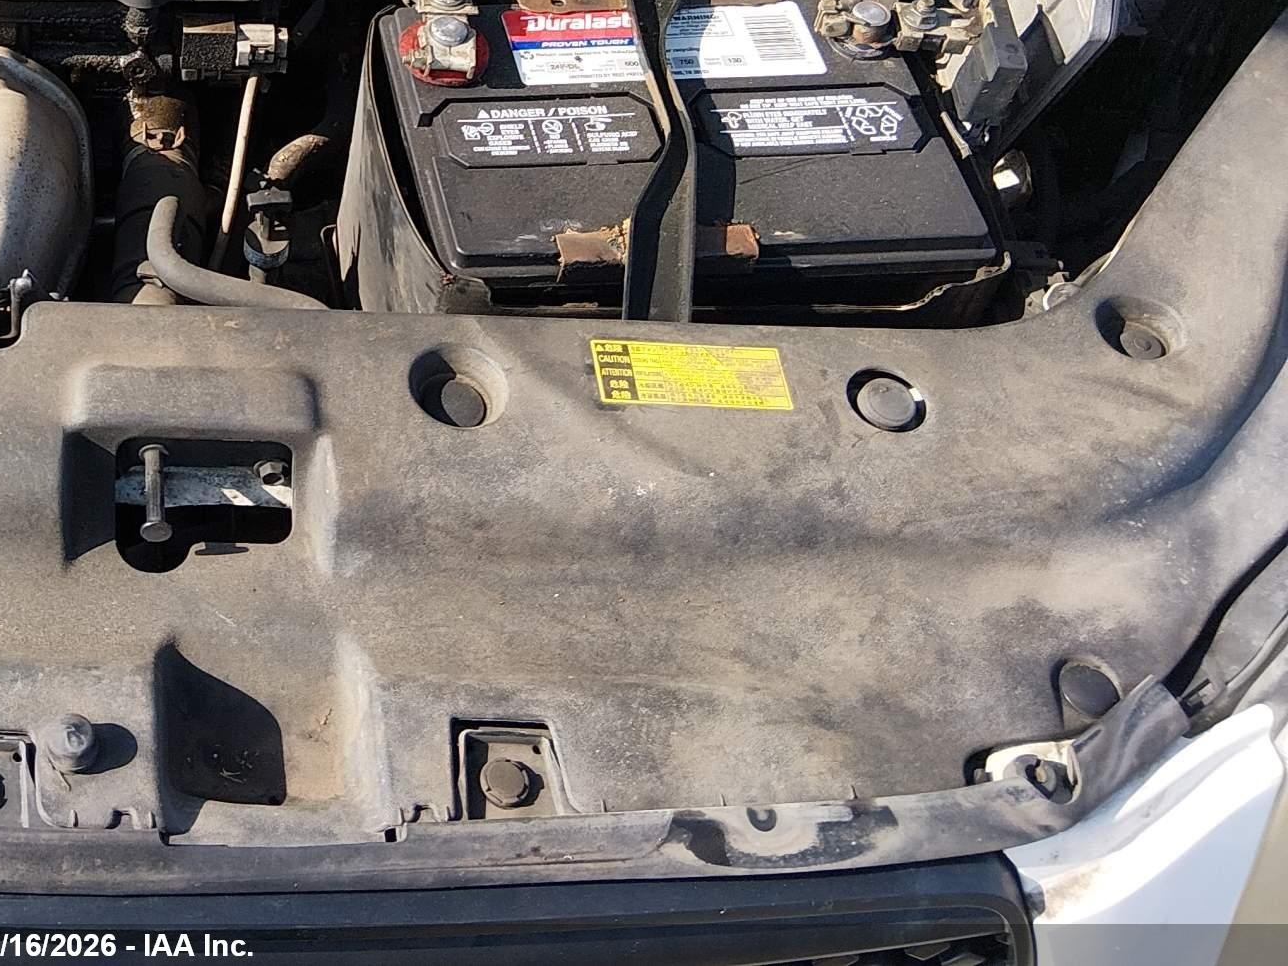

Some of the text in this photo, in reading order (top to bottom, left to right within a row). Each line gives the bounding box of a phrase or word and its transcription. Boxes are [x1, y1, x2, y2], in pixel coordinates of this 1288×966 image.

[520, 13, 633, 32] Duralast
[590, 38, 630, 46] TOUGH
[490, 107, 546, 118] DANGER
[558, 105, 608, 116] POISON
[598, 354, 630, 363] CAUTION
